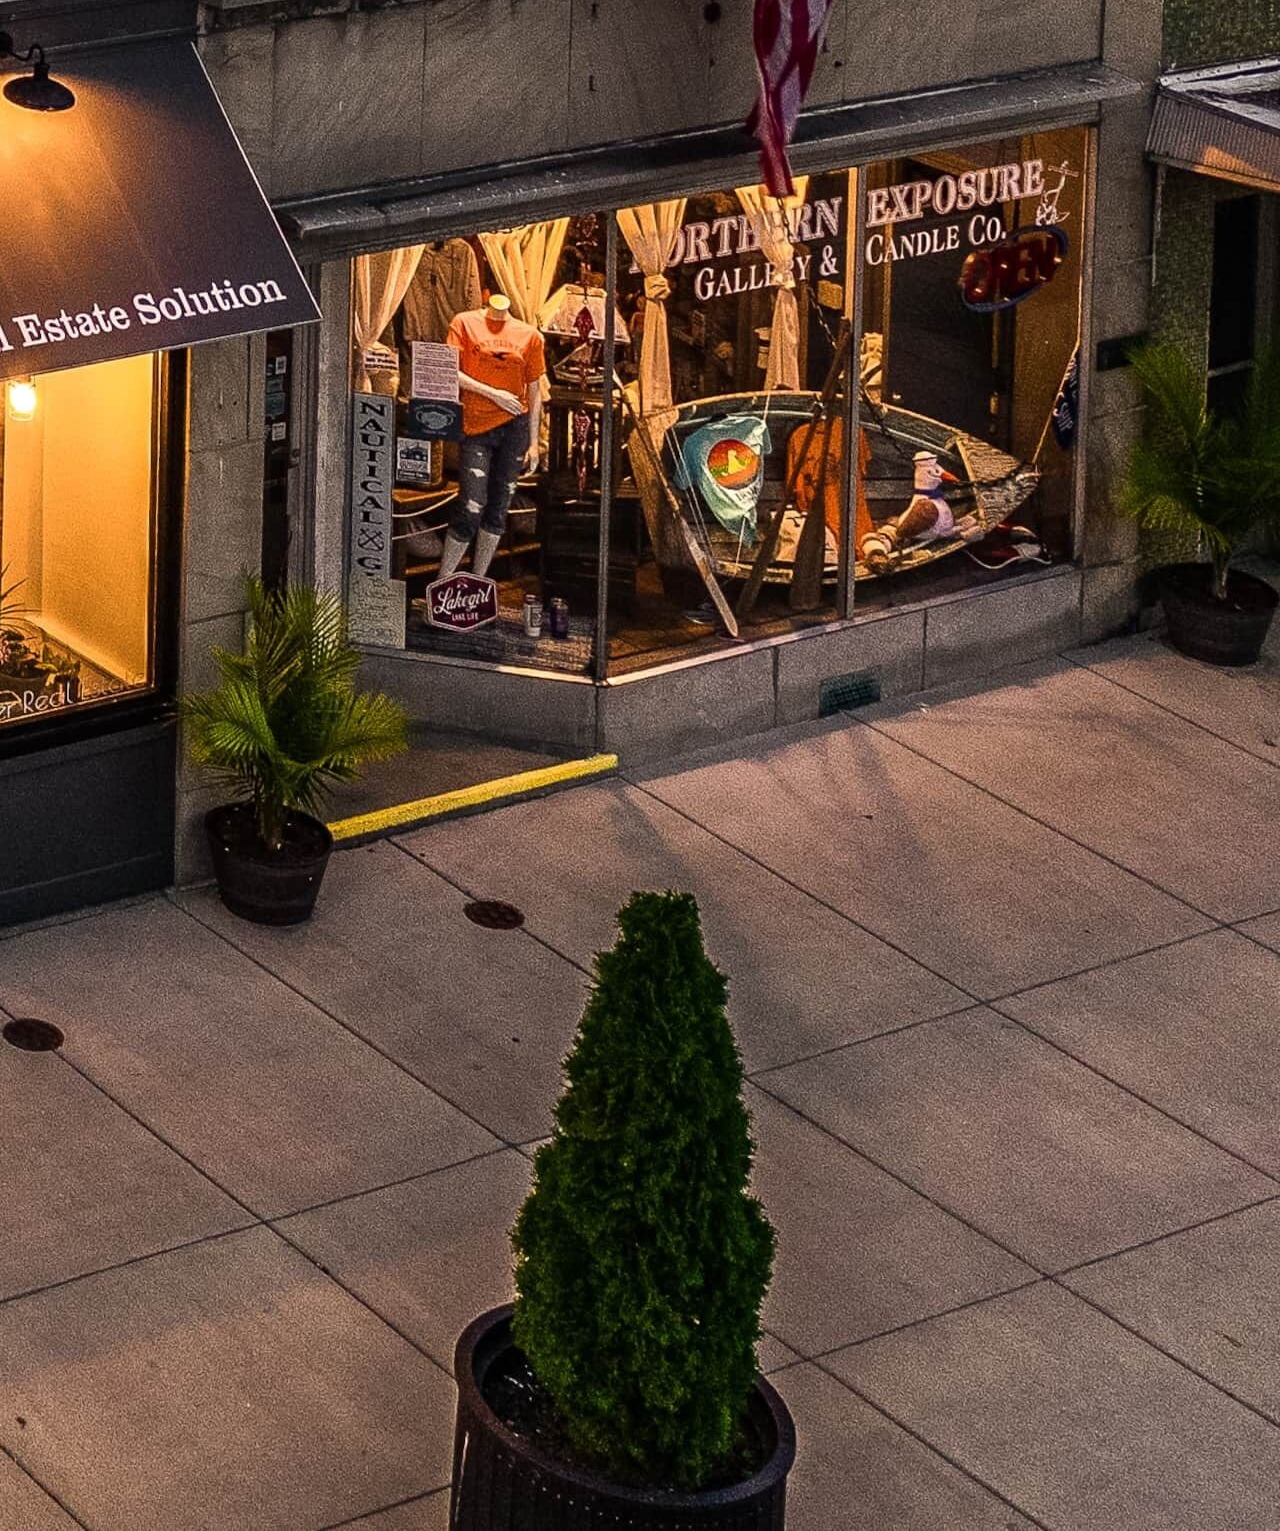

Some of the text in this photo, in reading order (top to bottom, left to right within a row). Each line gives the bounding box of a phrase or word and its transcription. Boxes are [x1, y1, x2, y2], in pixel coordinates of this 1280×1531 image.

[865, 158, 1046, 228] EXPOSURE
[819, 244, 839, 276] &
[864, 224, 960, 266] CANDLE
[13, 303, 131, 349] Estate
[133, 278, 287, 325] Solution
[358, 402, 387, 526] NAUTICAL
[433, 583, 492, 615] Lakegirl
[23, 681, 74, 714] Real
